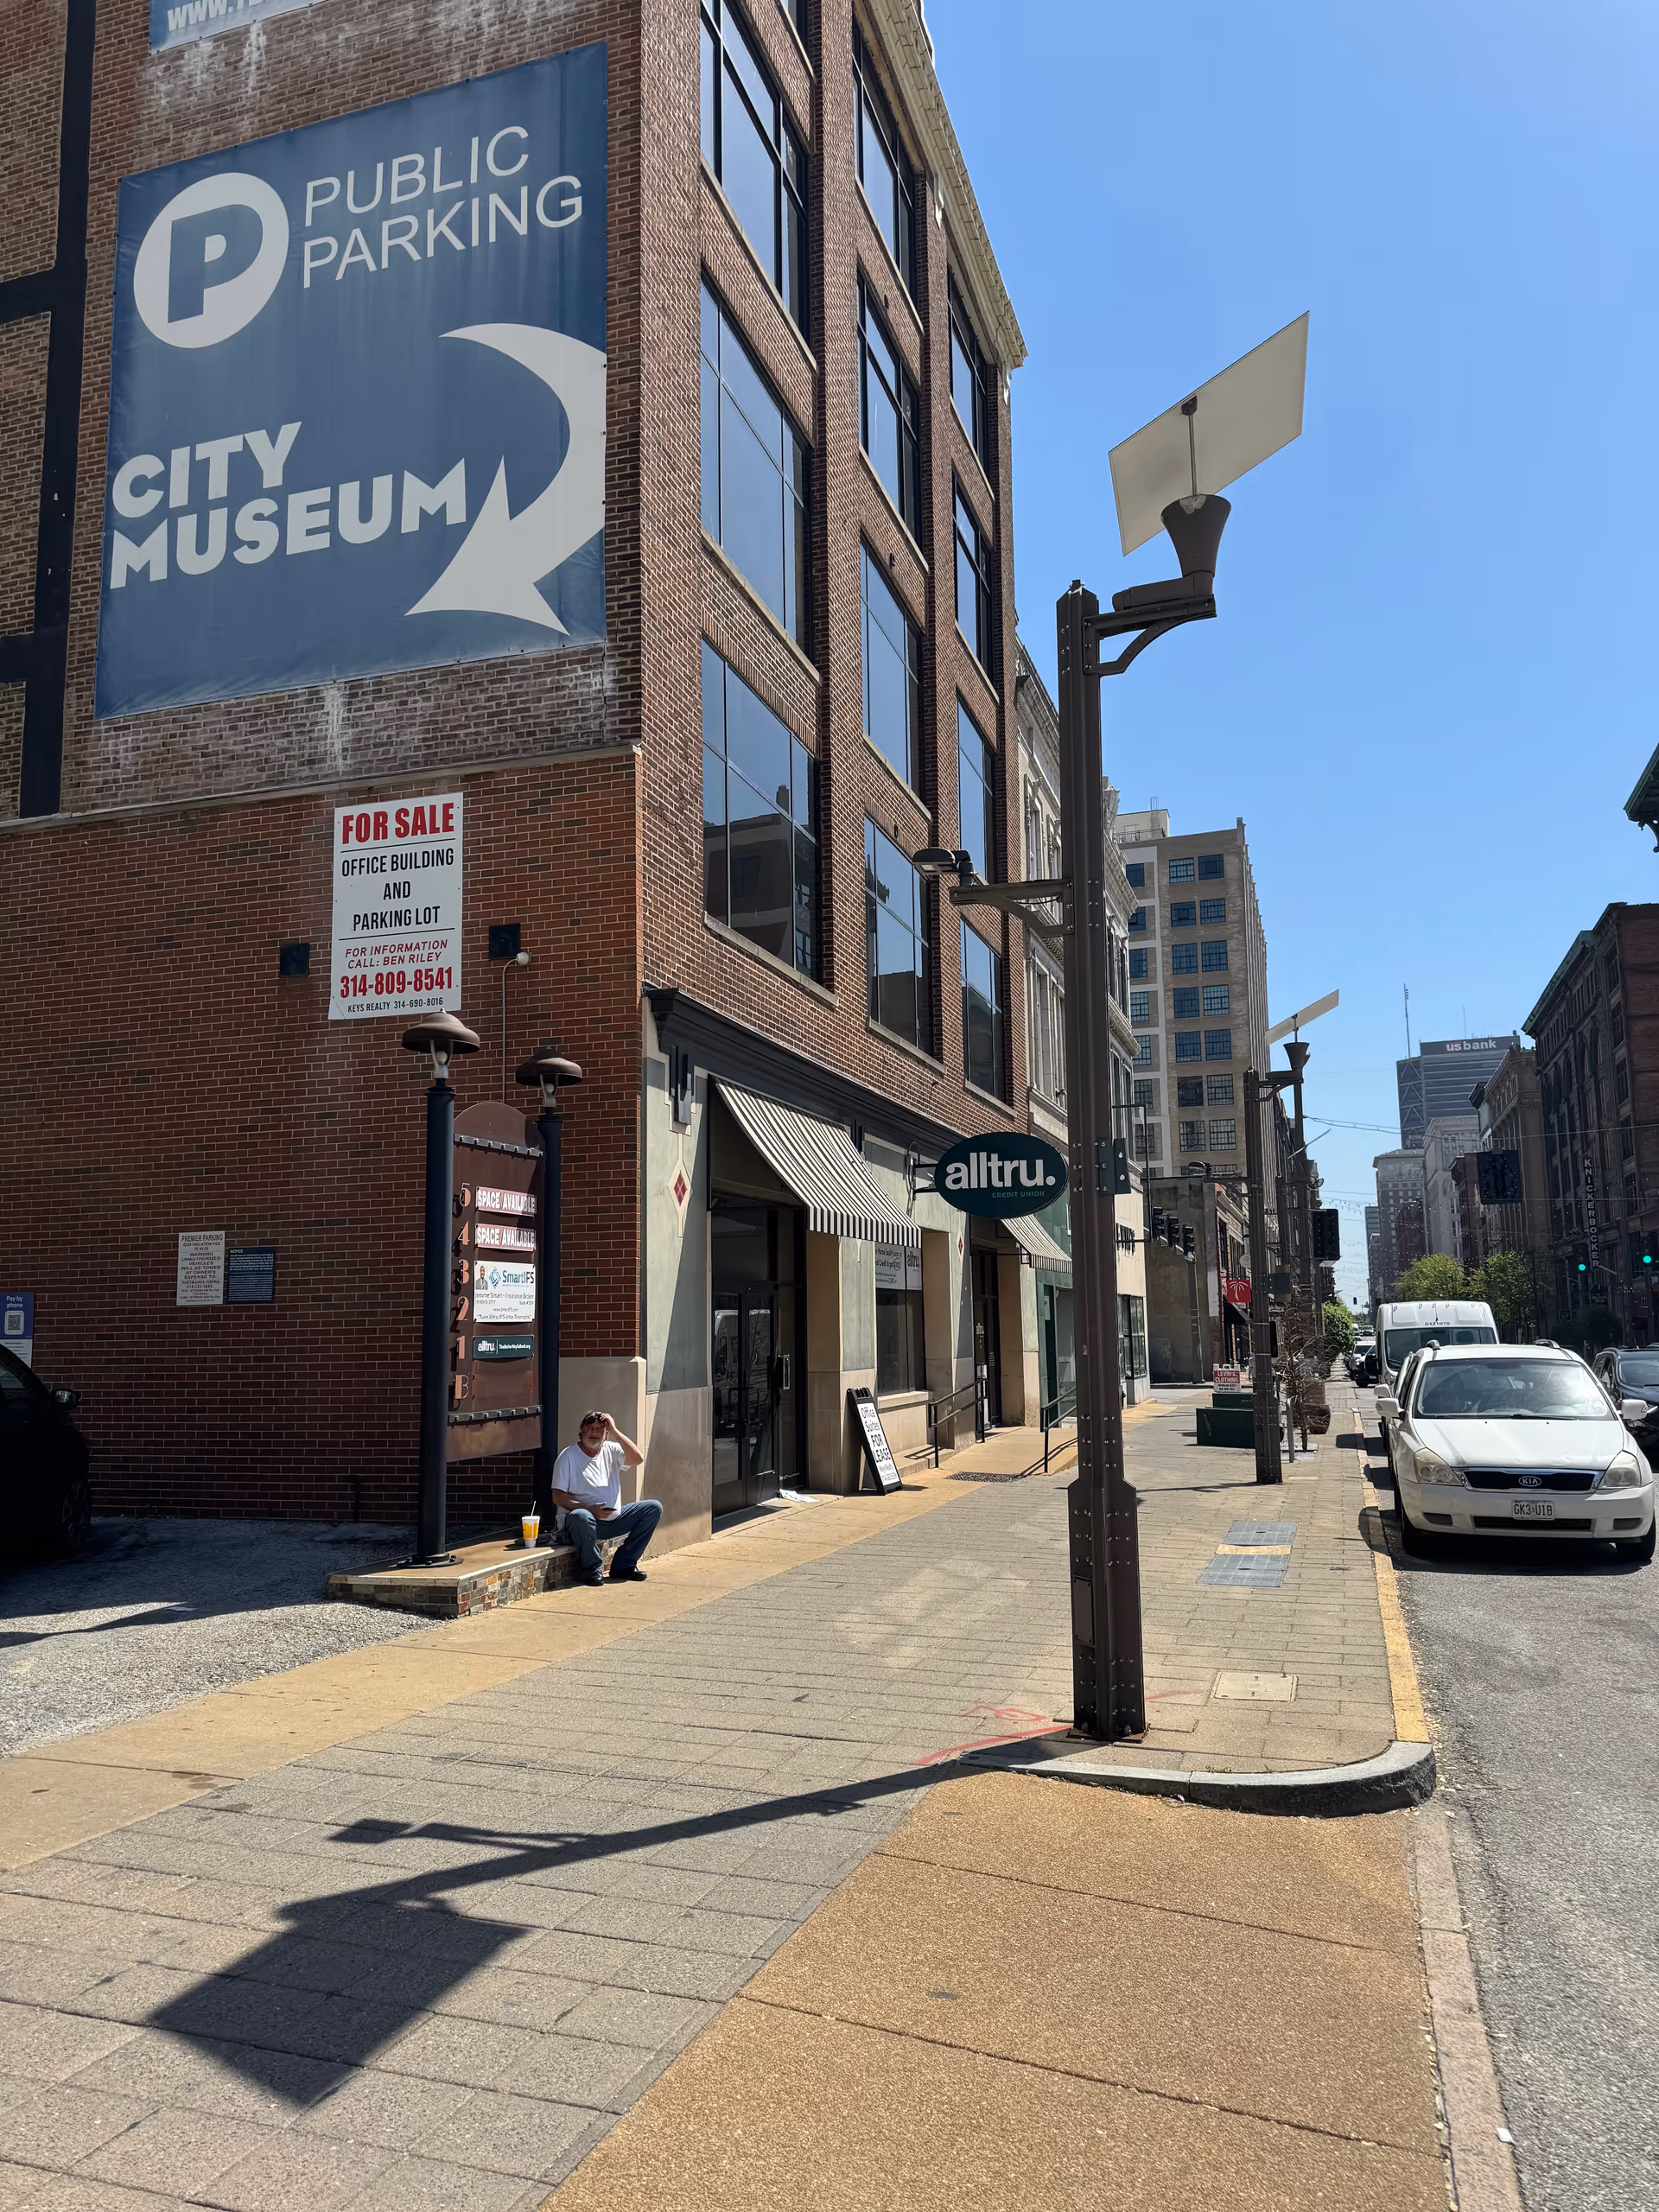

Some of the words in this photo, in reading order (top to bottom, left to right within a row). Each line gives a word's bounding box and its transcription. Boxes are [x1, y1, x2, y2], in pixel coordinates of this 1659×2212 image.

[304, 125, 530, 227] PUBLIC
[302, 175, 583, 289] PARKING
[111, 421, 302, 518] CITY
[110, 458, 467, 590] MUSEUM
[342, 810, 388, 844] FOR
[394, 803, 454, 839] SALE
[341, 855, 387, 877] OFFICE
[391, 848, 454, 873] BUILDING
[383, 880, 411, 900] AND
[353, 908, 412, 931] PARKING
[415, 906, 441, 925] LOT
[345, 947, 368, 958] FOR
[370, 939, 448, 957] INFORMATION
[347, 957, 380, 969] CALL:
[383, 955, 406, 966] BEN
[408, 951, 442, 964] RILEY
[340, 966, 453, 999] 314-809-8541
[347, 1003, 365, 1013] KEYS
[365, 1001, 391, 1012] REALTY
[393, 996, 444, 1009] 314-690-8016
[945, 1152, 1056, 1190] alltru.
[460, 1183, 471, 1206] 5
[477, 1191, 501, 1209] SPACE
[502, 1193, 536, 1213] AVAILABLE
[1584, 1159, 1599, 1268] KNICKERBOCKER
[458, 1221, 470, 1246] 4
[477, 1228, 500, 1245] SPACE
[502, 1229, 535, 1248] AVAILABLE
[456, 1259, 470, 1286] 3
[502, 1269, 535, 1284] SmartIFS
[456, 1296, 469, 1322] 2
[456, 1335, 466, 1360] 1
[455, 1375, 469, 1400] B
[864, 1420, 880, 1433] Suites
[870, 1433, 885, 1448] FOR
[873, 1447, 892, 1464] LEASE
[1514, 1503, 1531, 1516] GK3
